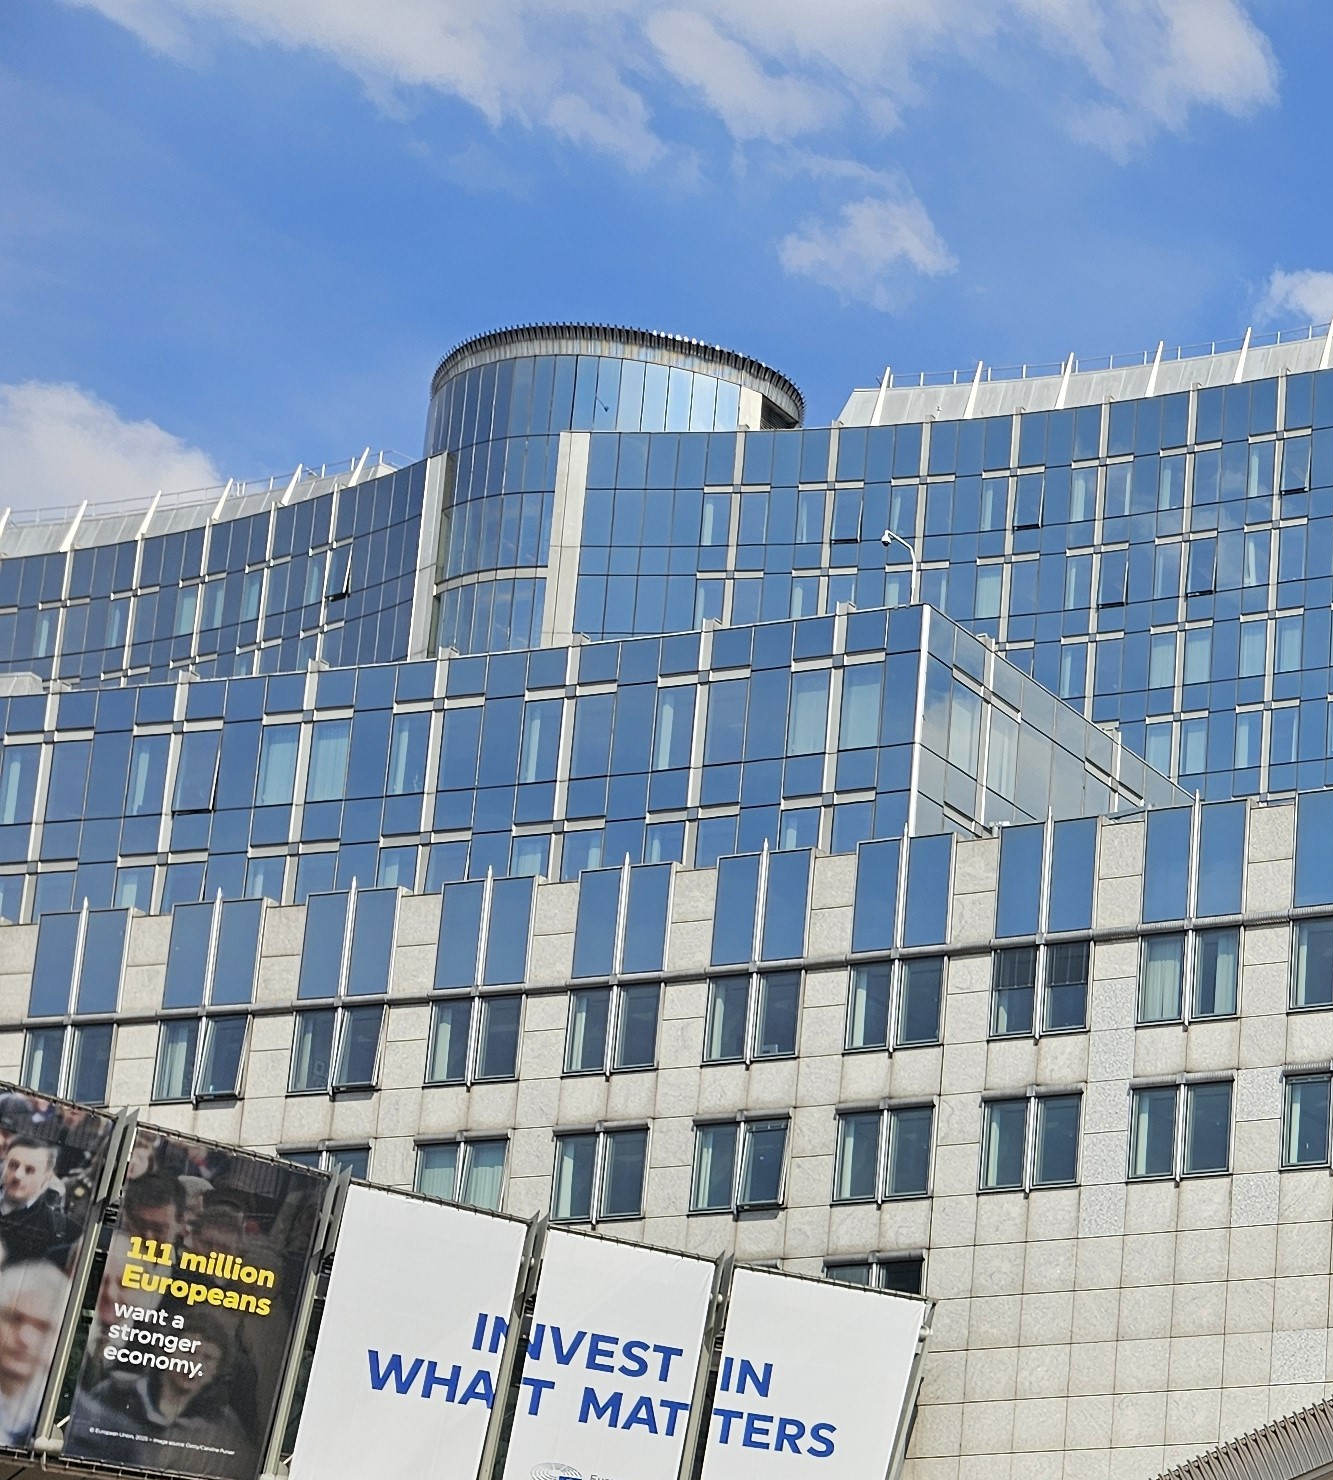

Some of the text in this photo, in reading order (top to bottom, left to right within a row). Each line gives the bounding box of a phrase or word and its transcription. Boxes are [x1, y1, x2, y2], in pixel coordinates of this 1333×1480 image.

[127, 1236, 275, 1288] 111 million
[122, 1263, 272, 1316] Europeans
[108, 1323, 202, 1354] stronger
[114, 1302, 185, 1330] want a
[103, 1345, 203, 1379] economy.
[472, 1312, 774, 1398] INVEST IN
[367, 1348, 837, 1458] WHAT MATTERS
